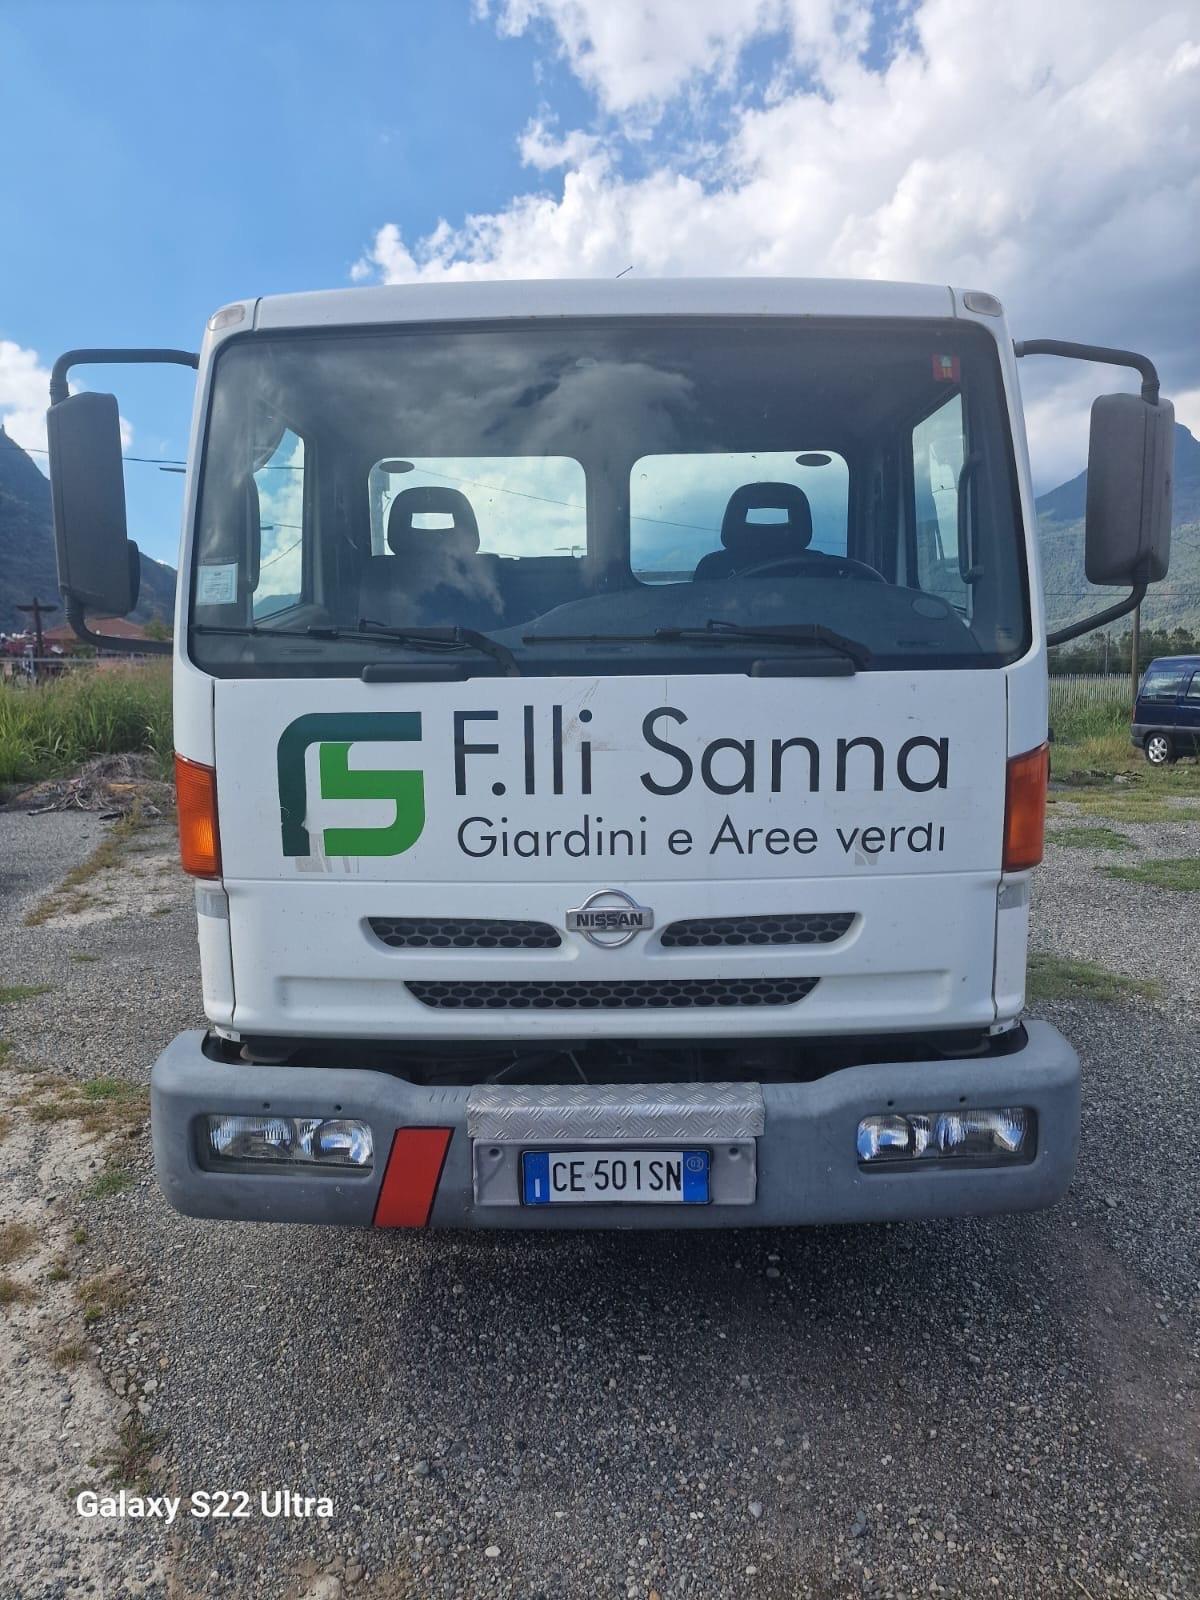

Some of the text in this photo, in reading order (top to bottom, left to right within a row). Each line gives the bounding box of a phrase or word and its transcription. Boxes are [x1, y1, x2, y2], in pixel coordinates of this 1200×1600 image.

[453, 704, 951, 797] F.lli Sanna
[456, 813, 946, 859] Giardini e Aree verdi
[576, 912, 644, 928] NISSAN
